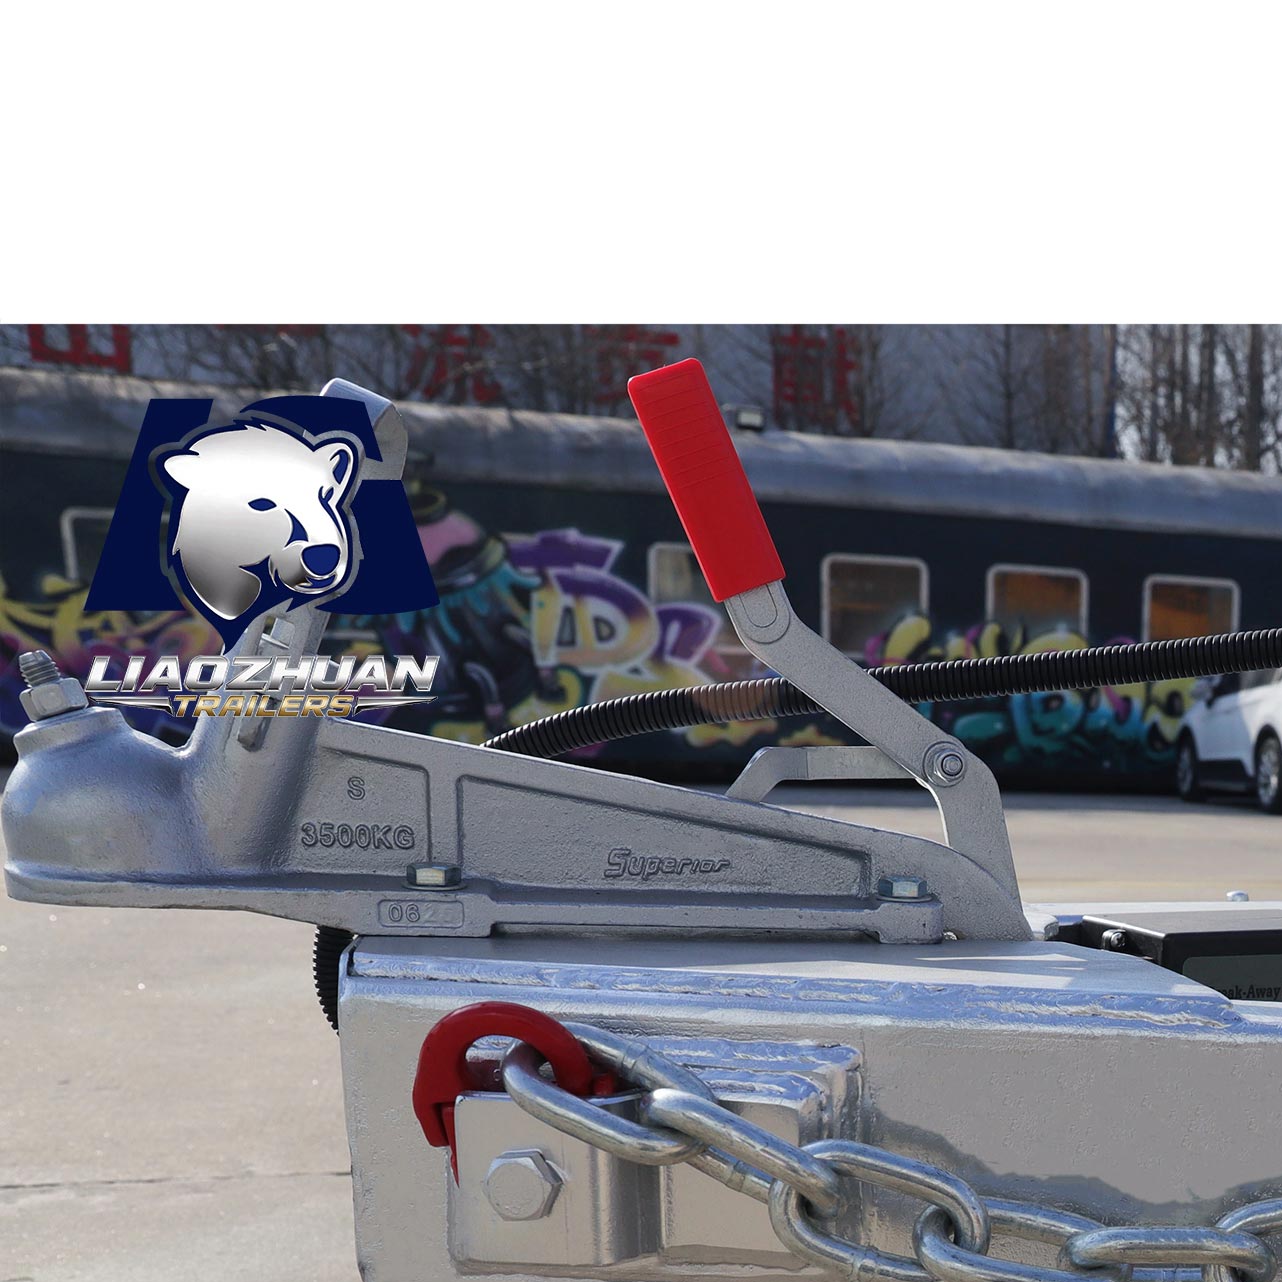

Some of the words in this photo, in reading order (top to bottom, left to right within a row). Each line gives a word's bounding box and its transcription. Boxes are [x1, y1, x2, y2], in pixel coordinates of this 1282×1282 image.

[347, 777, 366, 800] S
[301, 821, 415, 849] 3500KG
[604, 848, 731, 880] Superior
